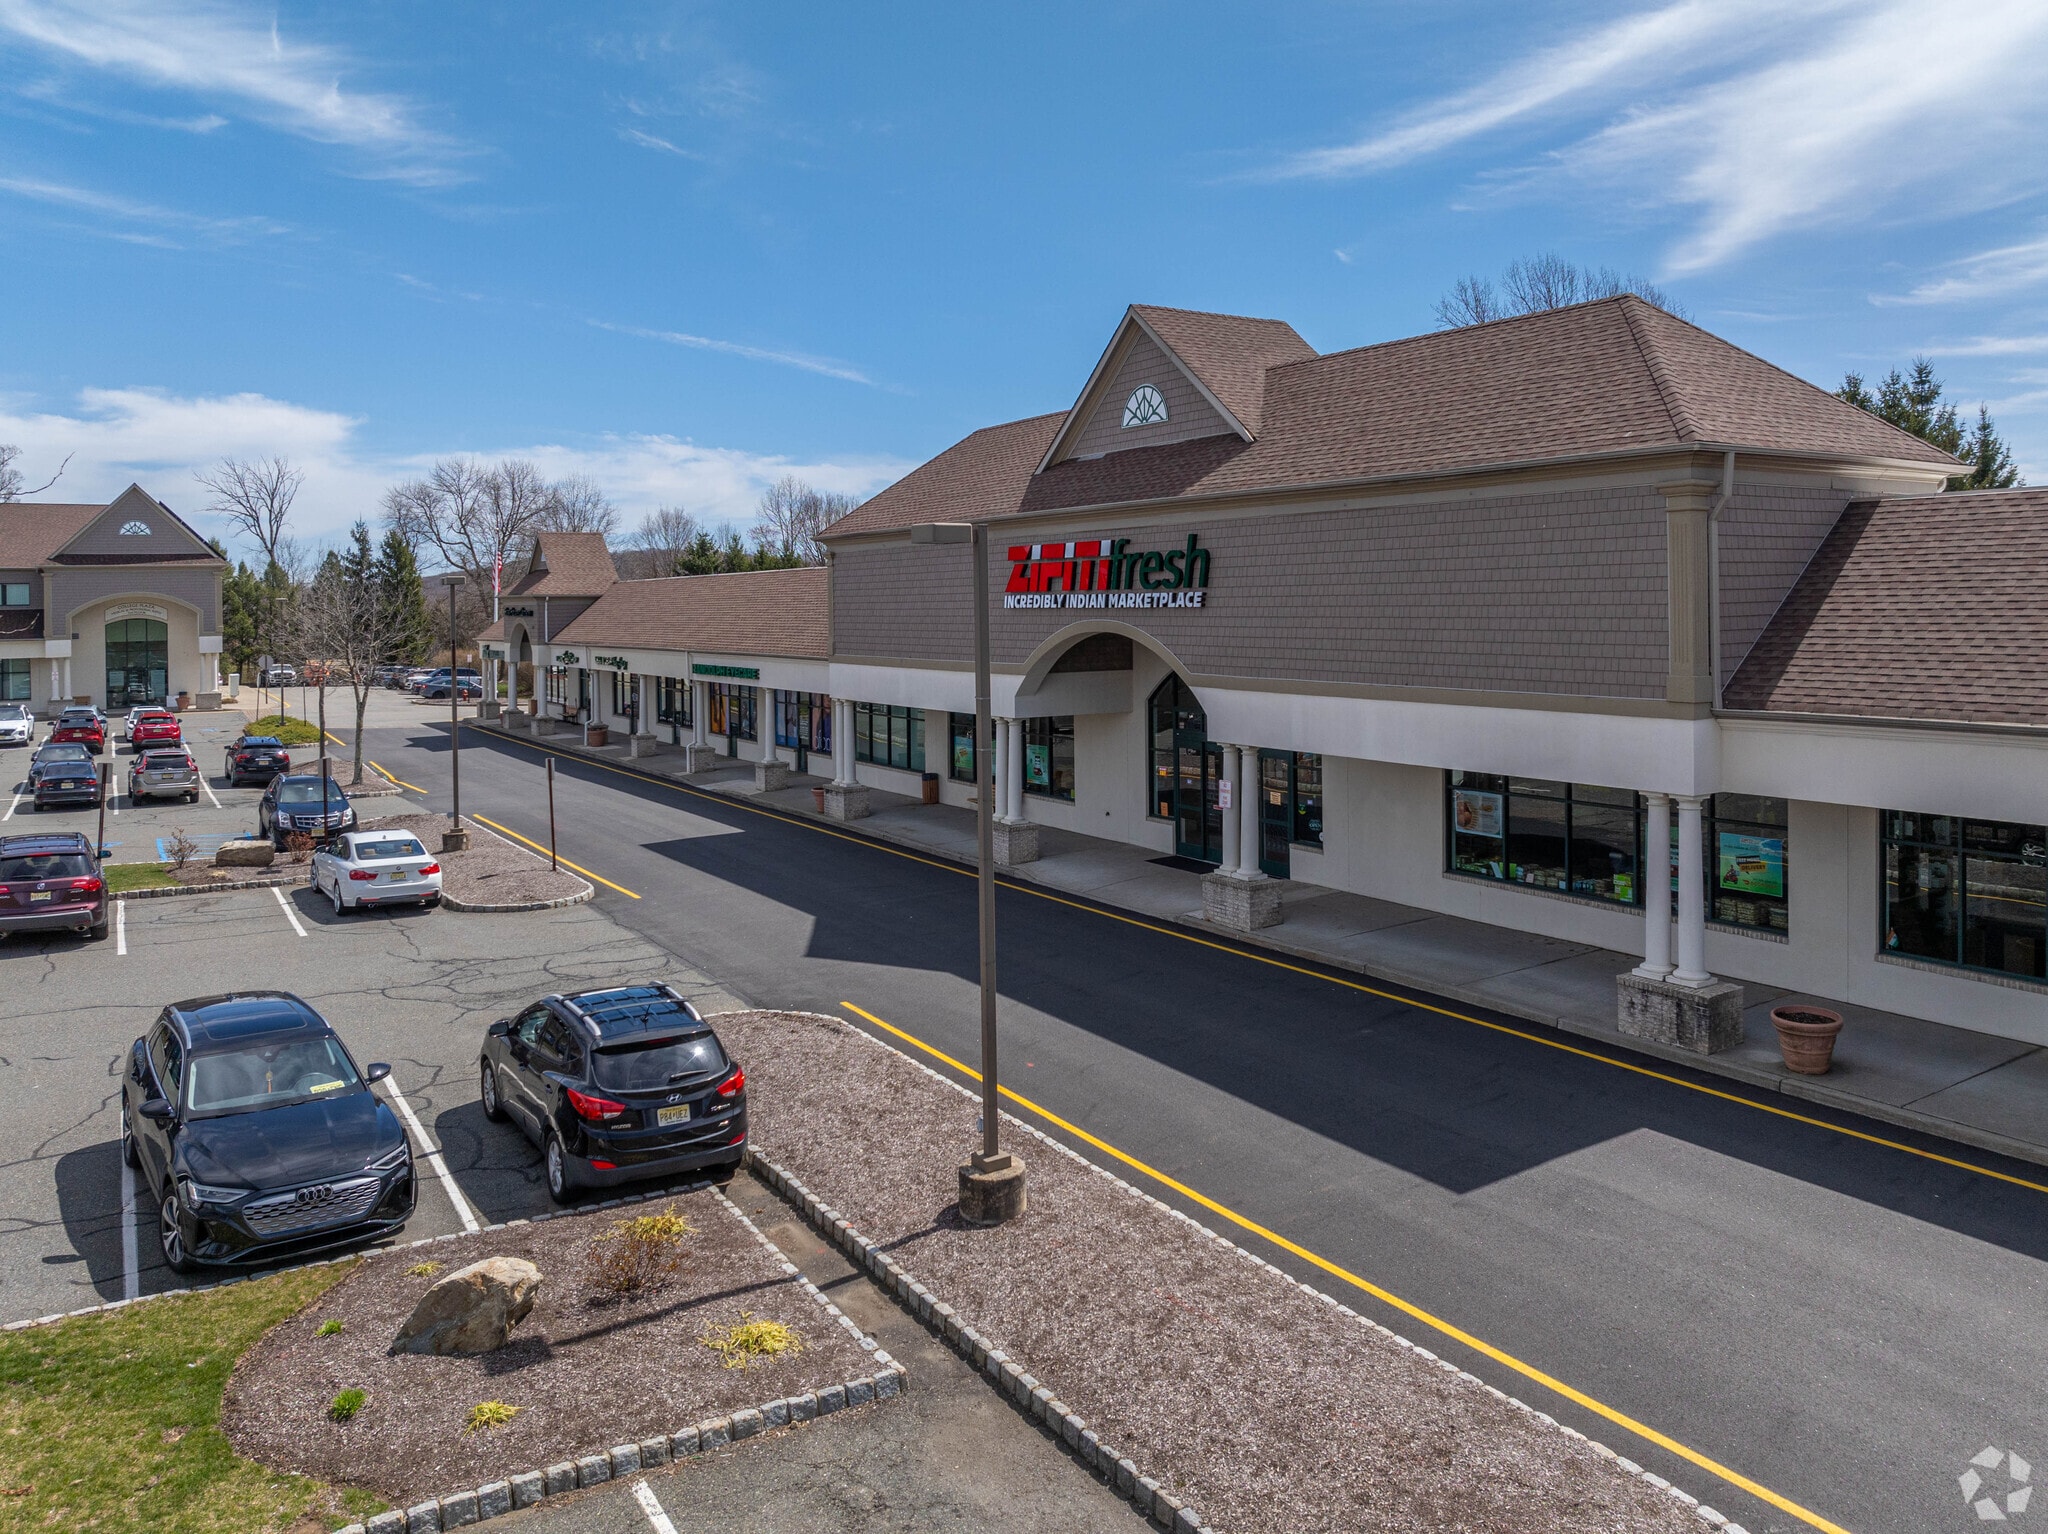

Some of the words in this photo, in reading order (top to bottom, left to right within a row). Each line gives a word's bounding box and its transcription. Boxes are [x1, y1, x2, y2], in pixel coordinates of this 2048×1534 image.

[1004, 594, 1063, 608] INCREDIBLY
[1066, 594, 1106, 608] INDIAN
[1108, 592, 1204, 608] MARKETPLACE
[726, 667, 760, 680] EYECARE
